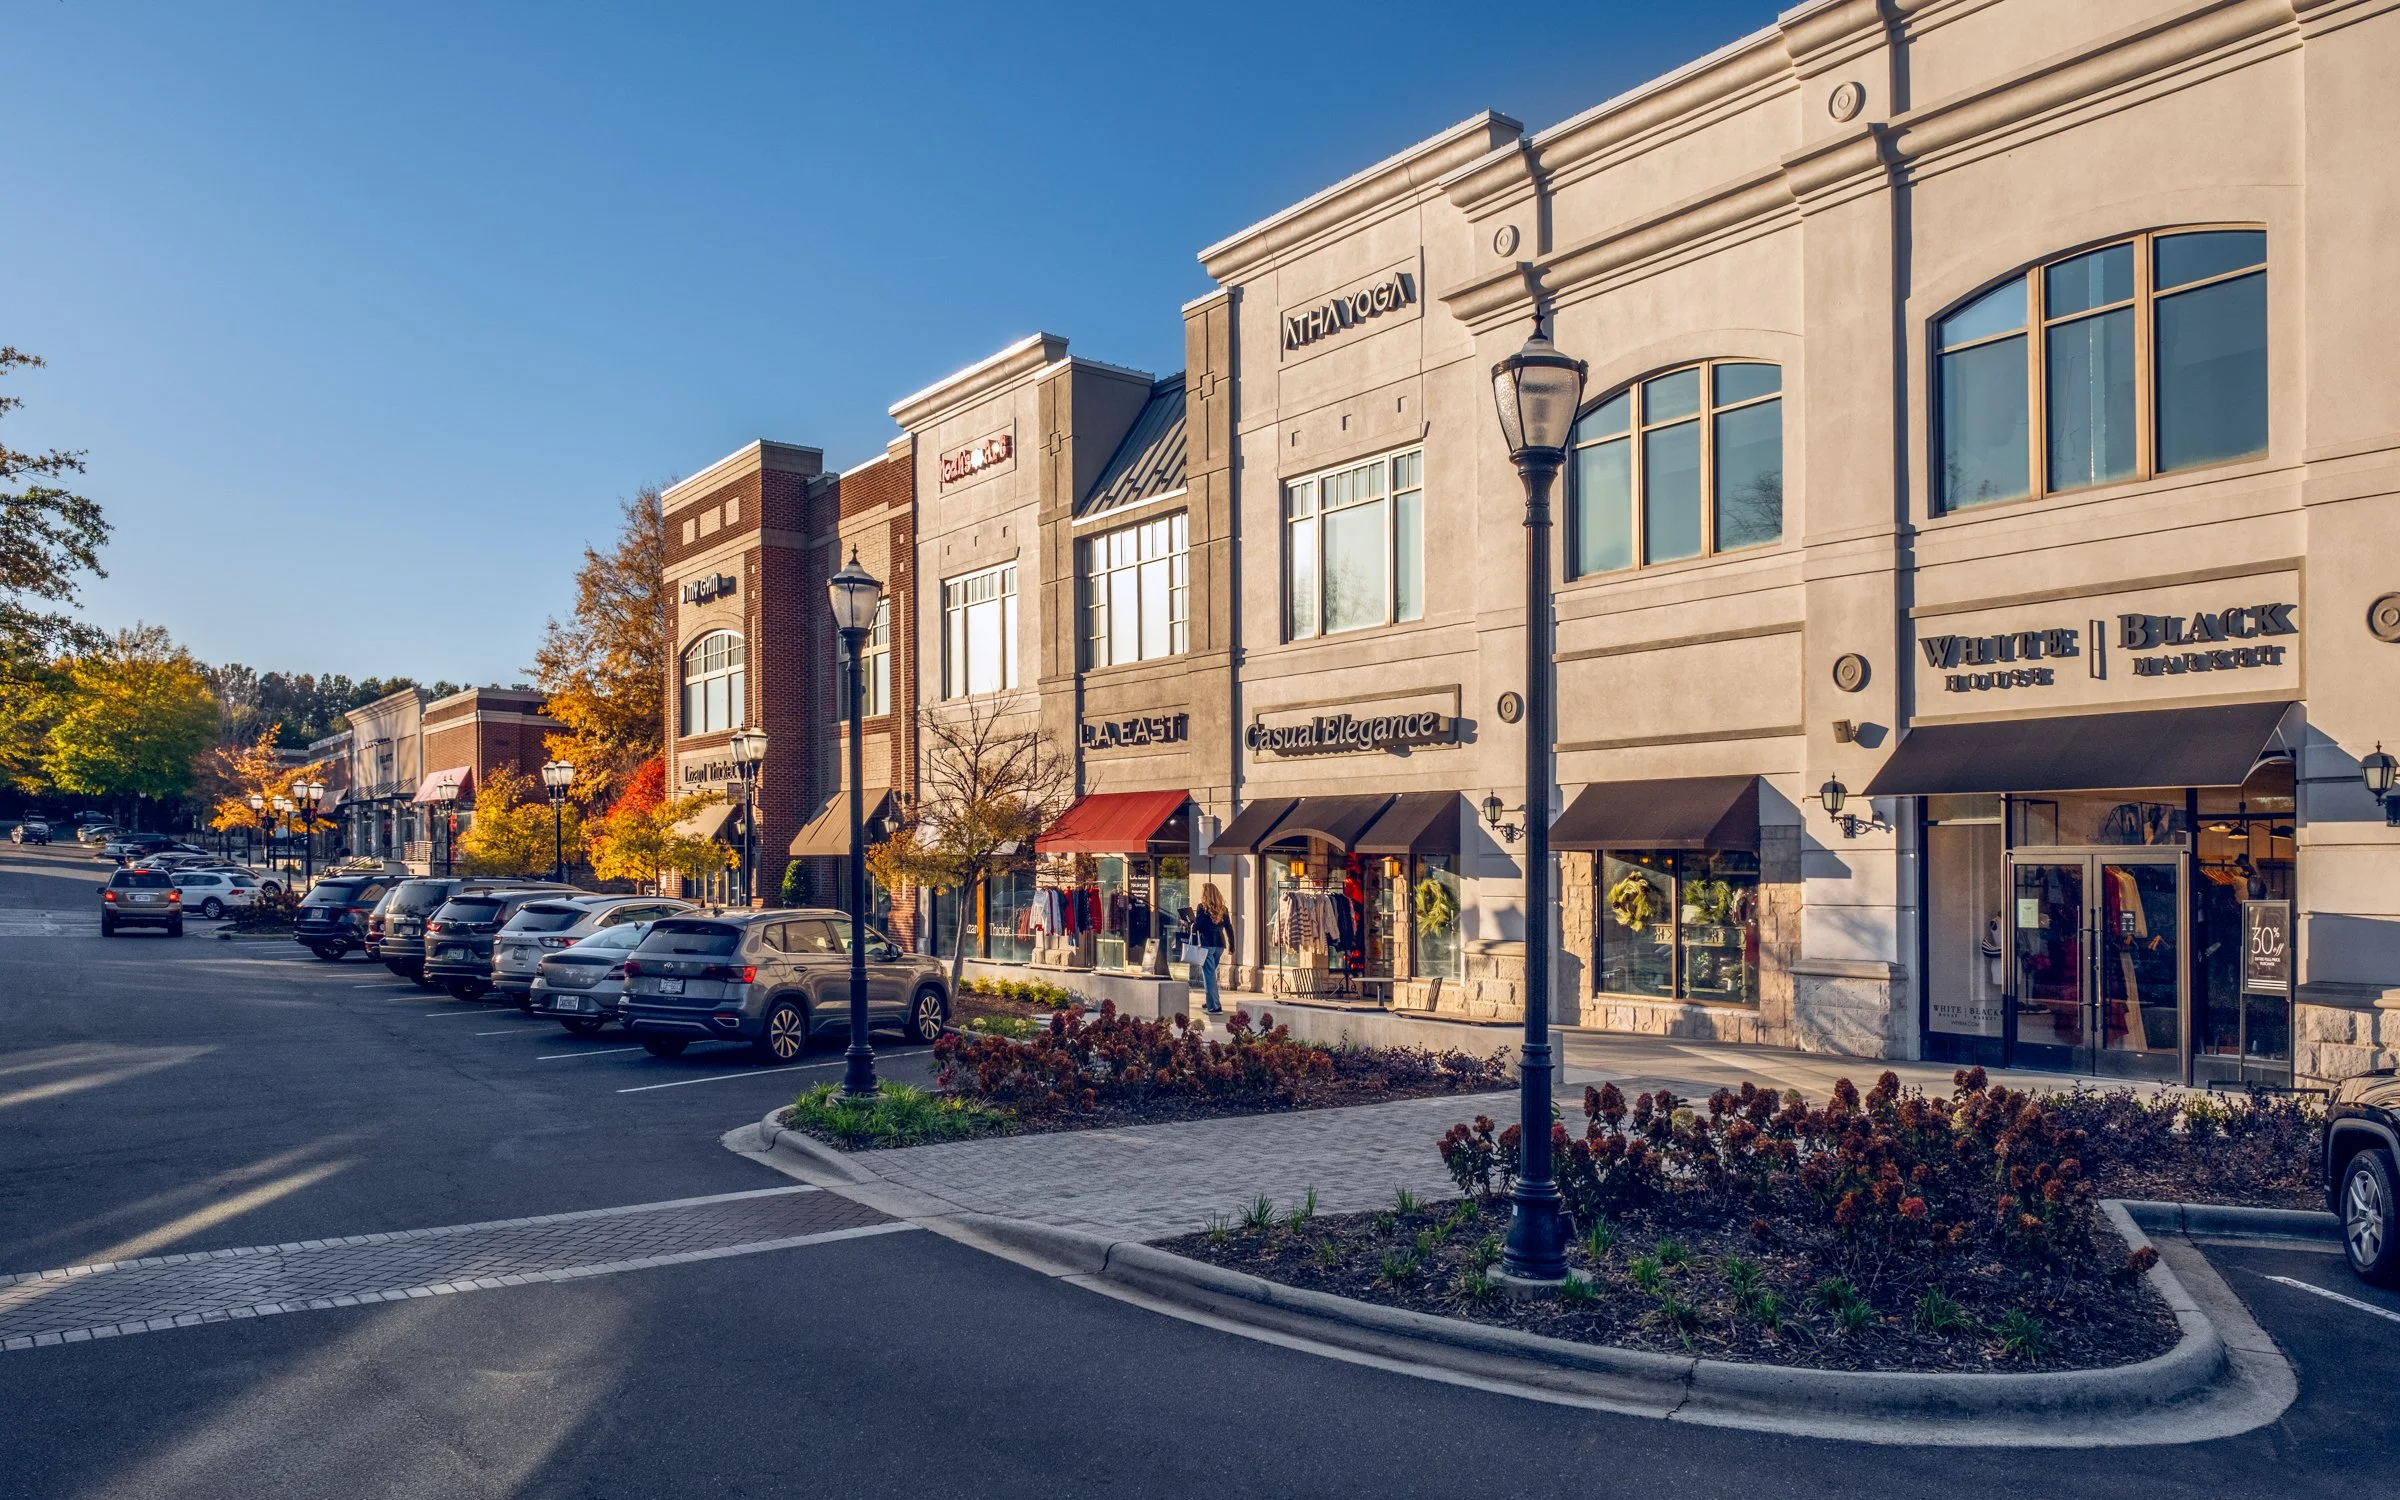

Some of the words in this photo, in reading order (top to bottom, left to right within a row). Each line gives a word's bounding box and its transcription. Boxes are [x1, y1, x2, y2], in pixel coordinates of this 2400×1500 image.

[1283, 298, 1342, 350] ATHA
[1343, 271, 1408, 325] YOGA
[700, 572, 719, 597] GYM
[2117, 602, 2294, 650] BLACK
[1919, 627, 2071, 669] WHITE
[2132, 644, 2279, 677] MARKET
[1944, 667, 2049, 692] HOUSE
[1079, 721, 1116, 748] L.A.
[1120, 714, 1182, 744] EAST
[1245, 716, 1322, 751] Casual
[1323, 711, 1438, 750] Elegance
[1933, 1004, 1962, 1014] WHITE
[1969, 1007, 1999, 1017] BLACK
